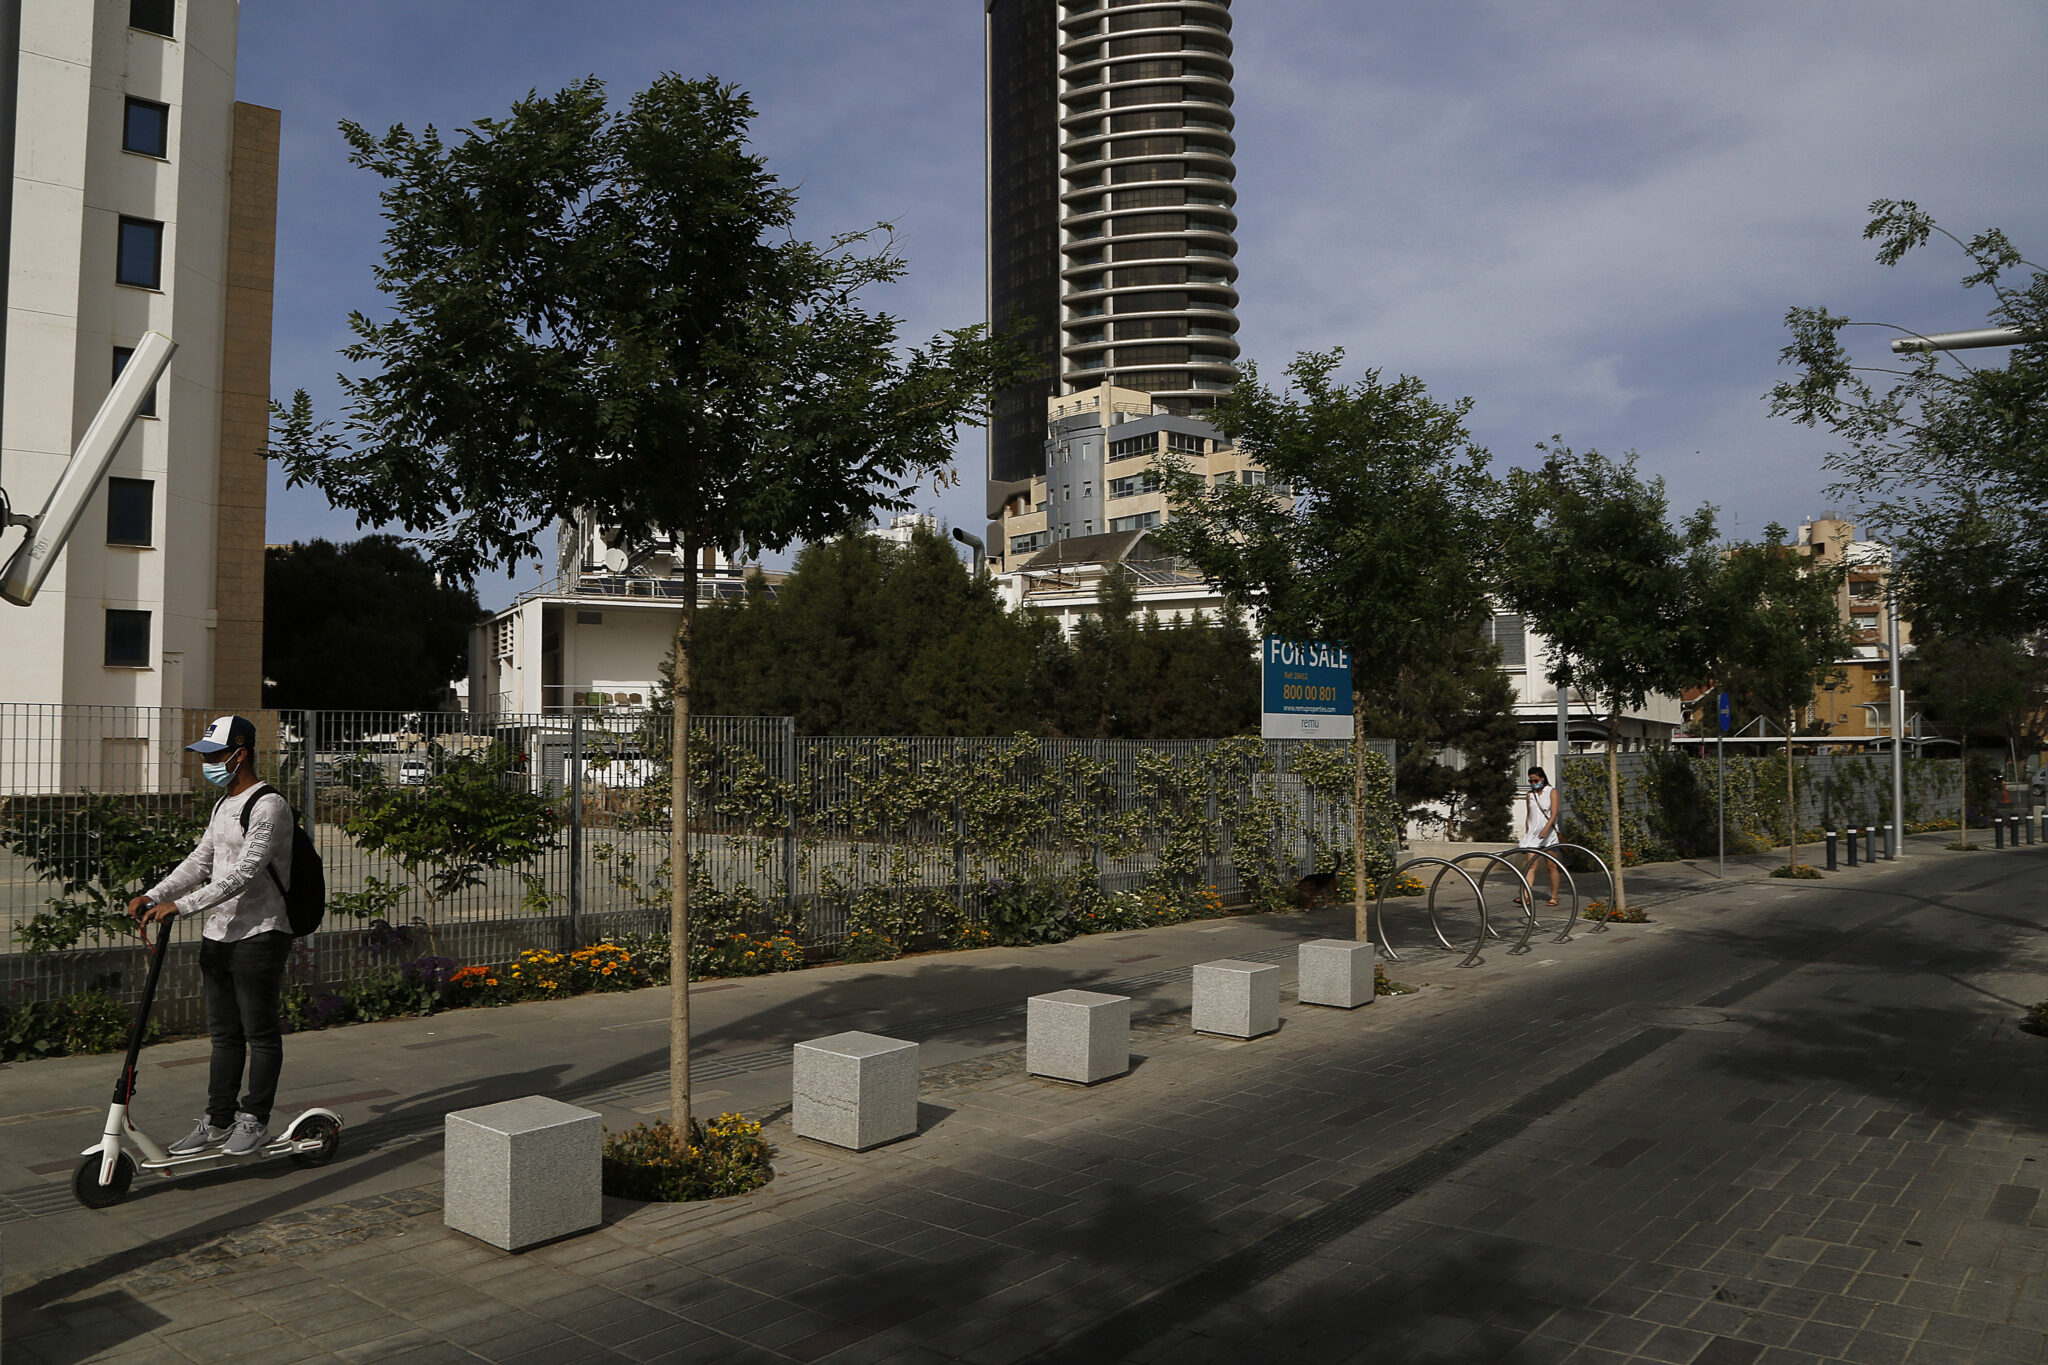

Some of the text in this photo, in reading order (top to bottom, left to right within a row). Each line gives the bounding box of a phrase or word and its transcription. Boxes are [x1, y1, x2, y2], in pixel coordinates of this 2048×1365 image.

[1271, 639, 1348, 669] FOR SALE
[1283, 684, 1337, 702] 800 00 801
[1283, 705, 1337, 713] www.remuproperties.com
[1301, 719, 1320, 729] remu
[217, 821, 275, 896] HOLLISTER
